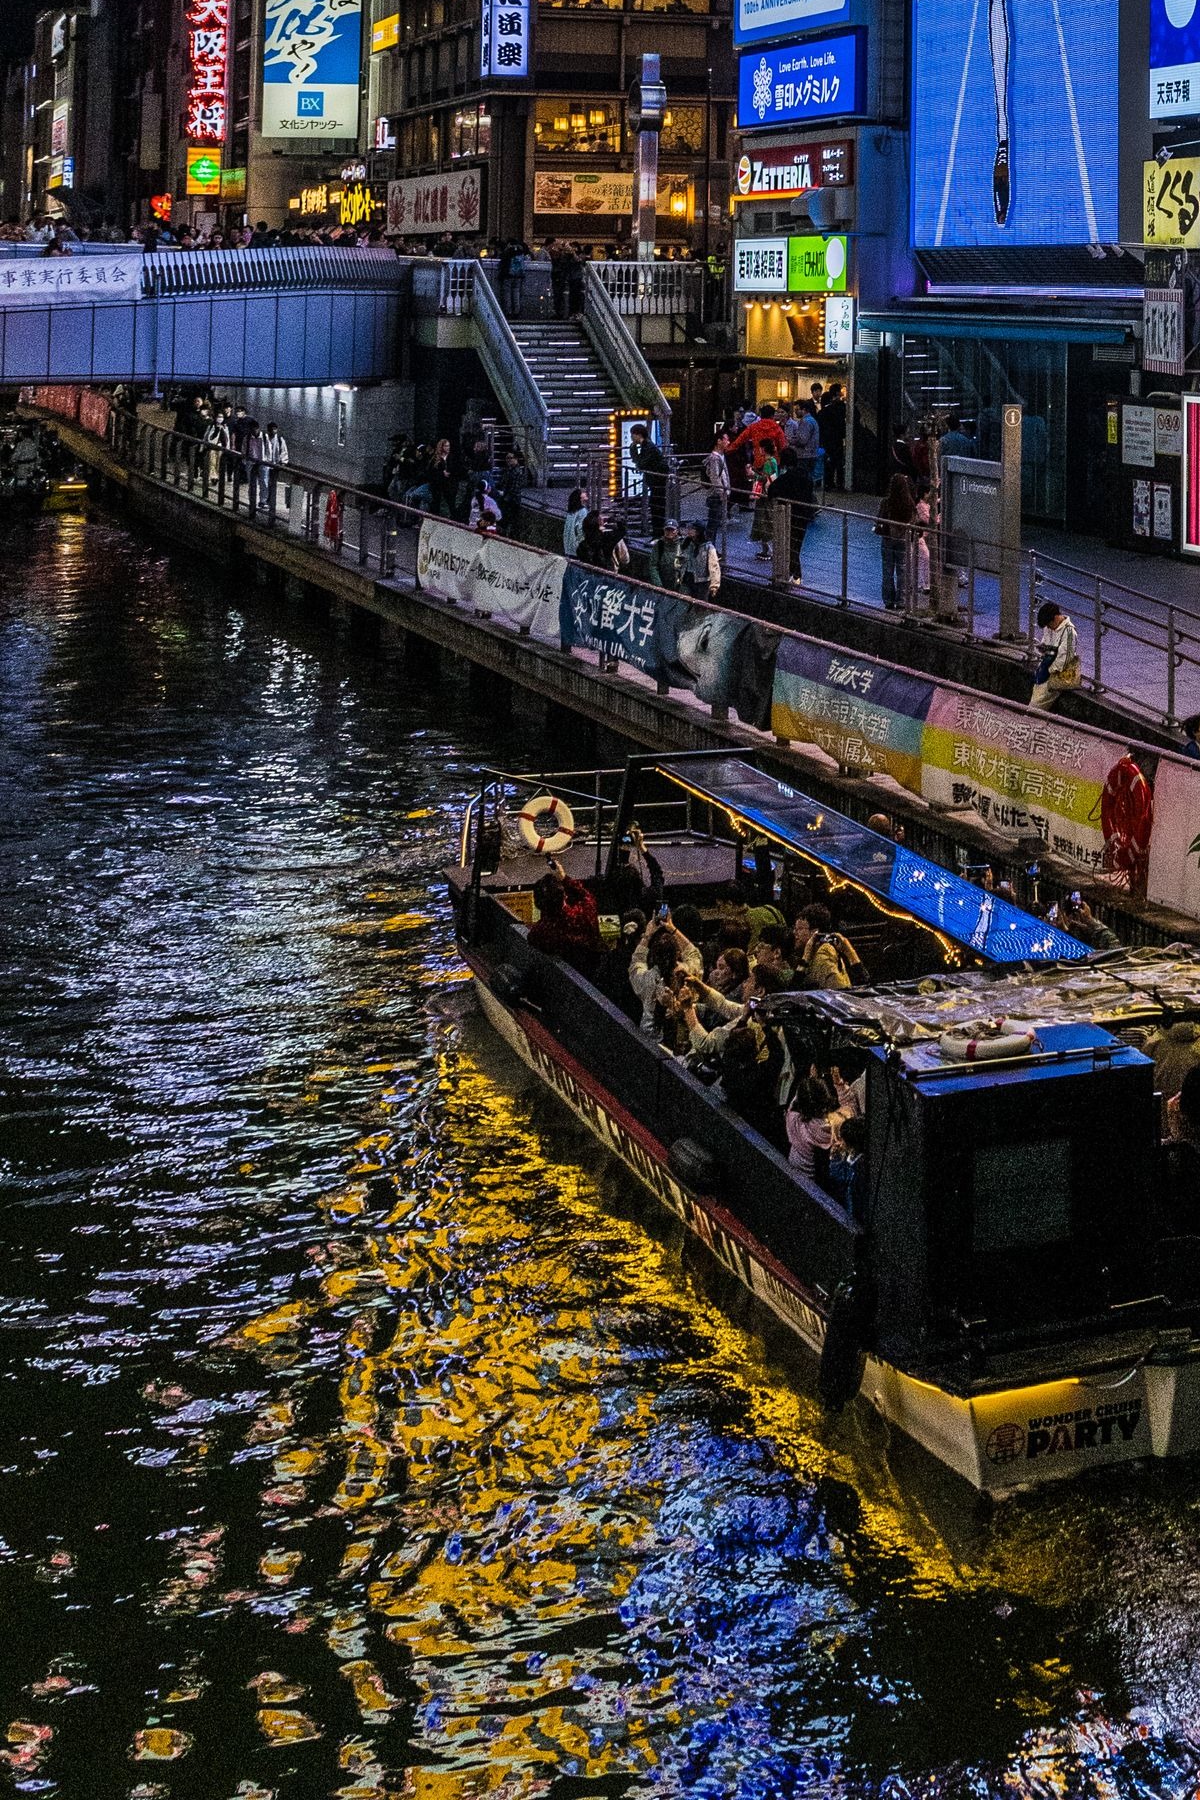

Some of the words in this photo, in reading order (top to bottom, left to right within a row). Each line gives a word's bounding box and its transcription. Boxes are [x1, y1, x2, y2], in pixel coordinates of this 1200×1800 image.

[779, 62, 791, 73] Love
[792, 57, 808, 71] Earth.
[810, 55, 823, 68] Love
[300, 97, 321, 112] BX
[775, 75, 840, 111] 雪印メグミルク
[1157, 79, 1190, 105] 天気予報
[752, 160, 812, 192] ZETTERIA
[1156, 170, 1199, 236] くくる
[1, 266, 127, 288] 事業実行委員会
[589, 584, 656, 647] 近畿大学
[1028, 1408, 1093, 1430] WONDER
[1026, 1410, 1141, 1458] PARTY
